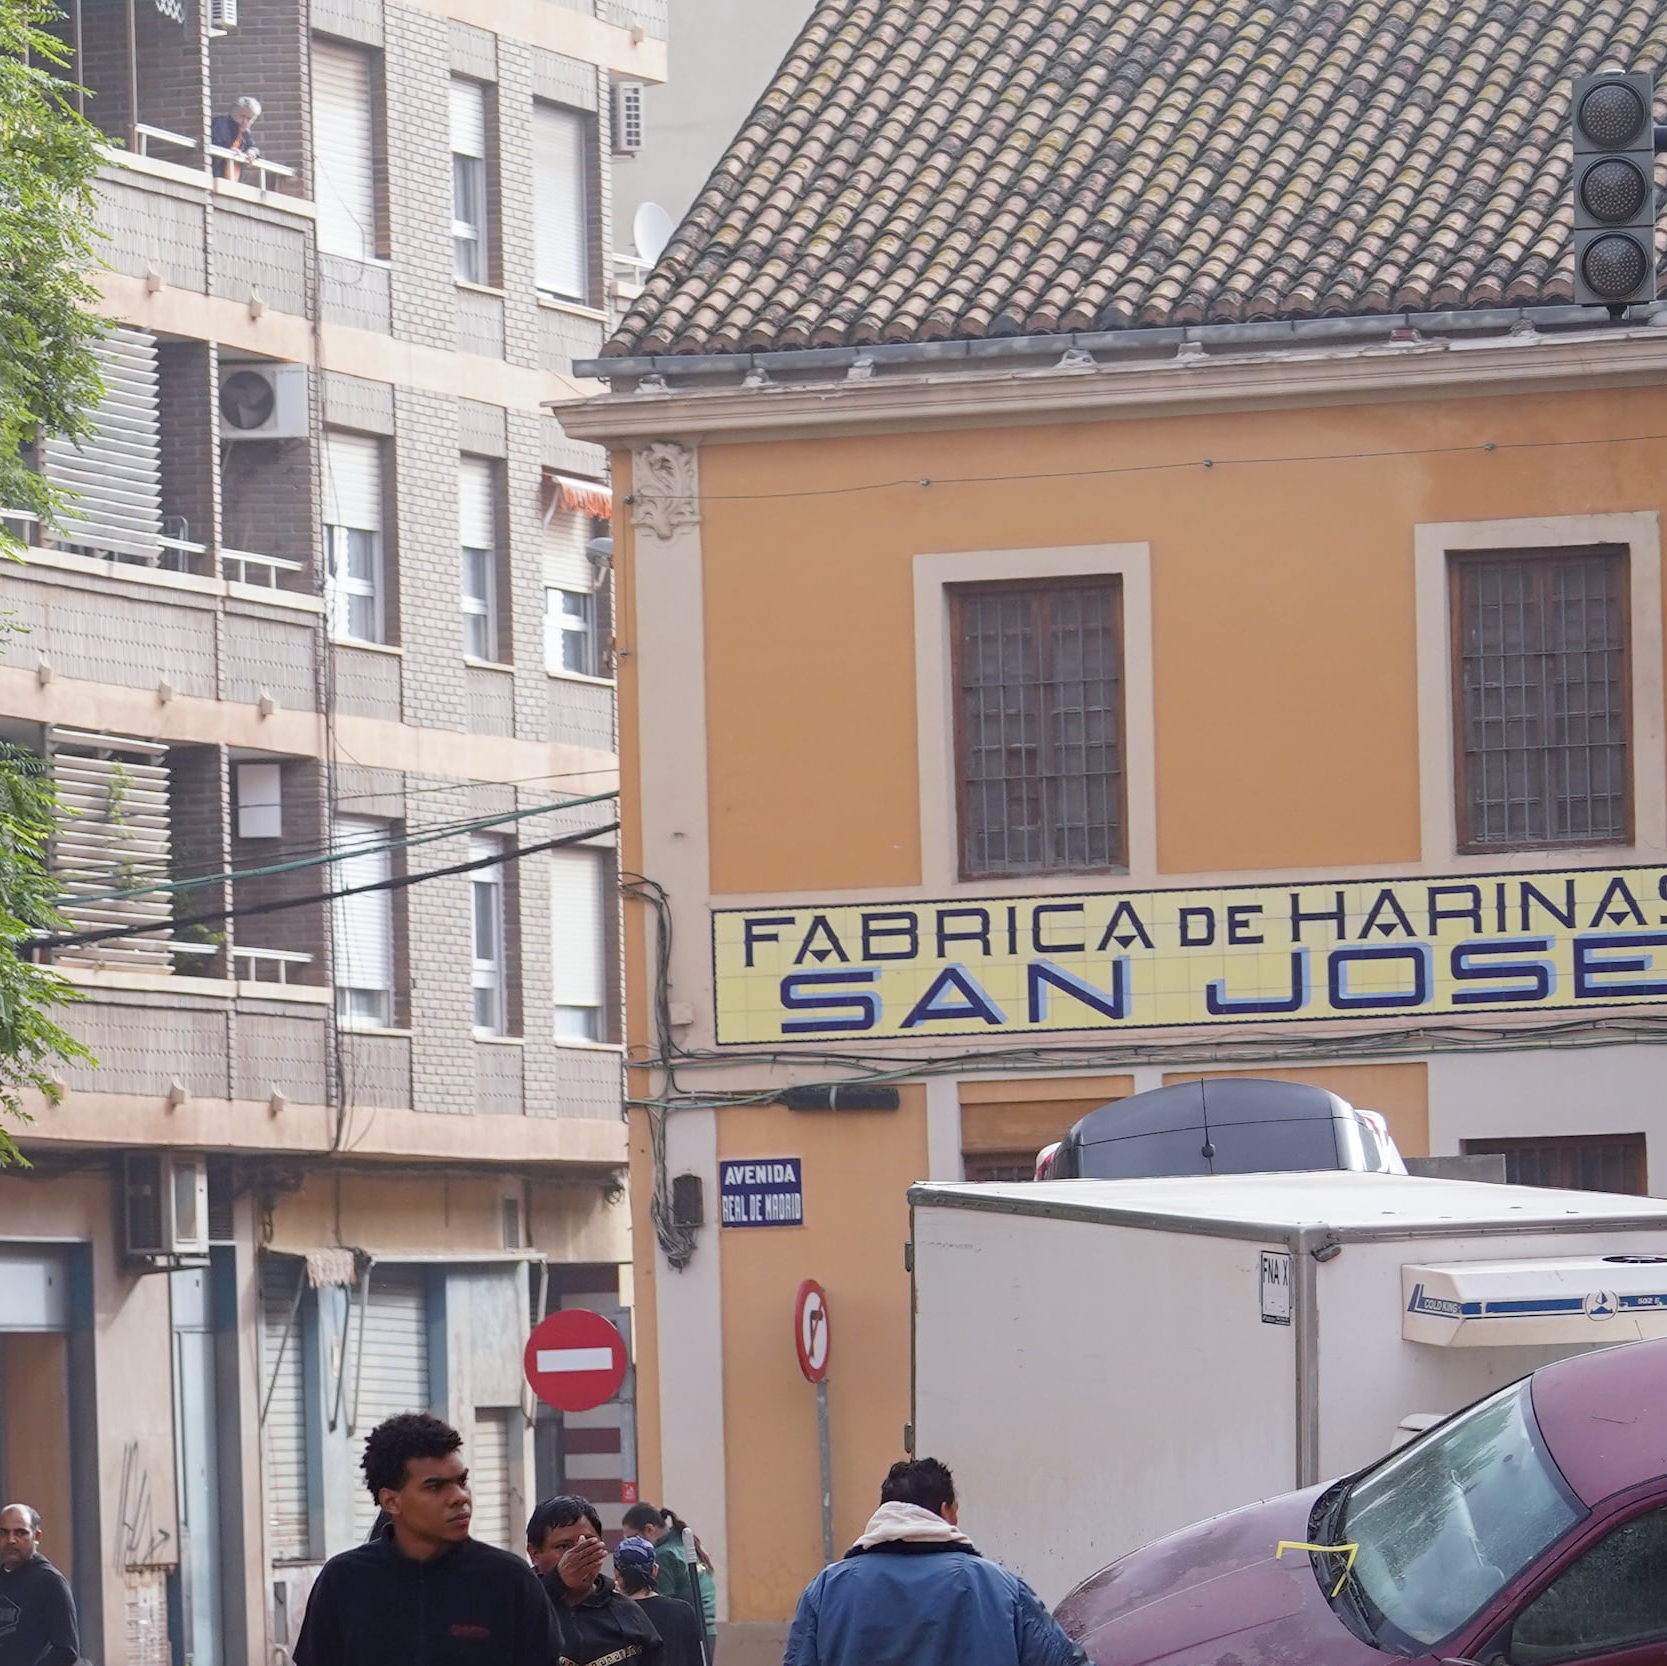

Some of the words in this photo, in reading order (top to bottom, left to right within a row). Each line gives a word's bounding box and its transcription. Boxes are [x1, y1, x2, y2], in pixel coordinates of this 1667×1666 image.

[743, 901, 1155, 967] FABRICA
[1179, 904, 1264, 947] DE
[1290, 872, 1667, 942] HARINA
[780, 955, 1132, 1034] SAN
[1206, 929, 1667, 1015] JOSE
[725, 1164, 797, 1186] AVENIDA
[722, 1194, 748, 1222] REAL
[749, 1194, 763, 1221] DE
[765, 1192, 801, 1221] MADRID
[1424, 1299, 1442, 1311] COLD
